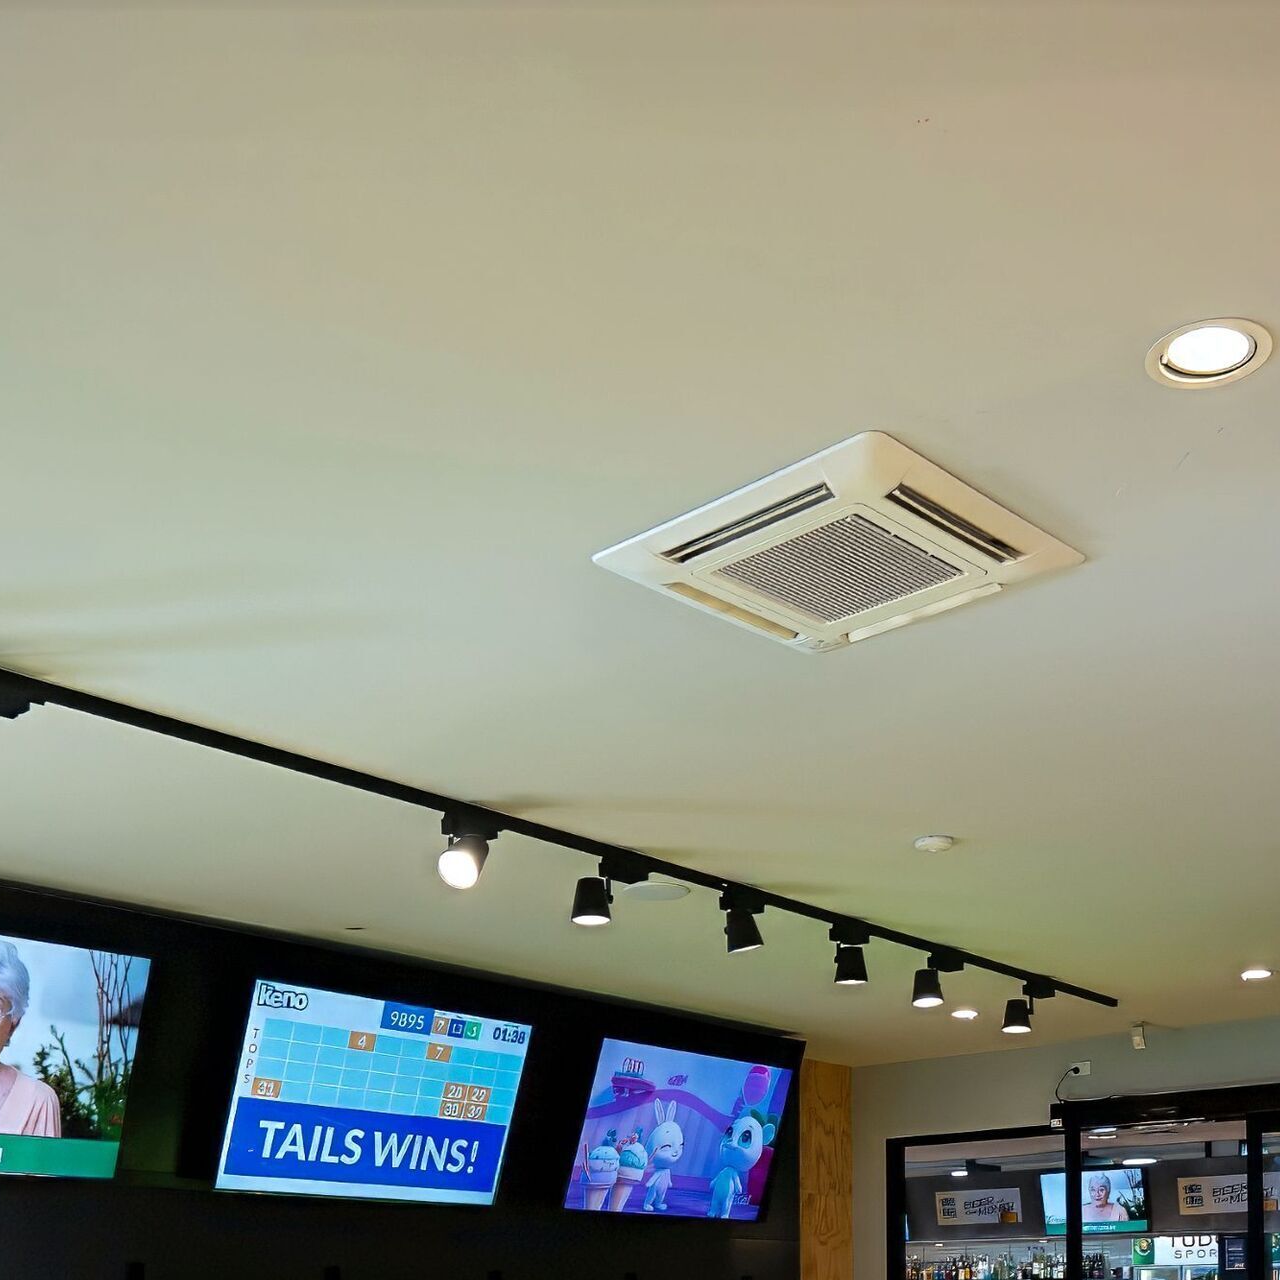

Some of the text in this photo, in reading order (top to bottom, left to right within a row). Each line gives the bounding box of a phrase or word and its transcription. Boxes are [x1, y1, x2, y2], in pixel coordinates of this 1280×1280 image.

[256, 983, 309, 1011] Keno
[390, 1011, 425, 1030] 9895
[358, 1034, 368, 1049] 4
[434, 1046, 444, 1060] 7
[259, 1120, 479, 1174] TAILS WINS!
[1170, 1235, 1219, 1248] TUD
